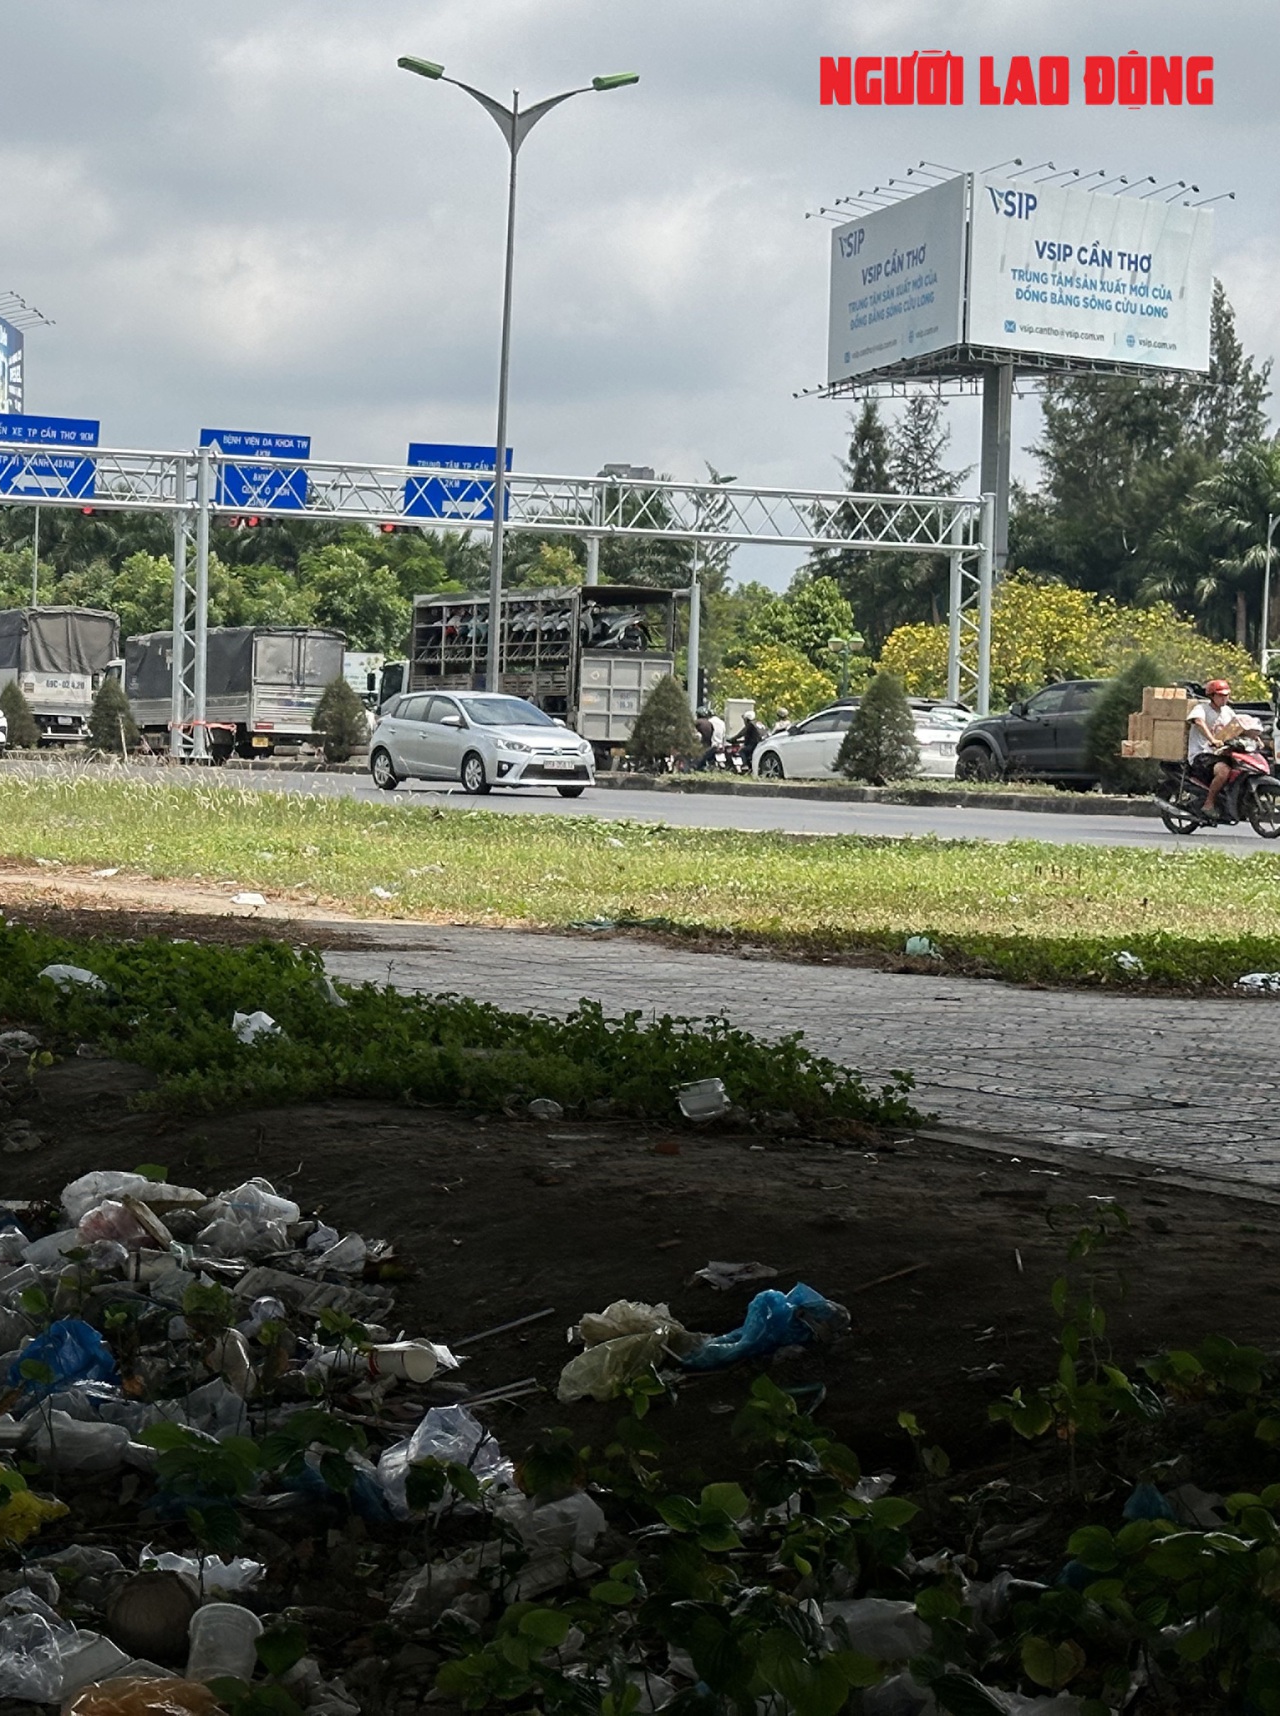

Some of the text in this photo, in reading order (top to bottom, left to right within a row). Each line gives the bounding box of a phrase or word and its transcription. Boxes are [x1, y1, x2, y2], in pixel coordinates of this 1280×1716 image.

[985, 185, 1038, 220] VSIP
[861, 262, 882, 286] VSIP
[906, 243, 927, 270] THƠ
[1035, 240, 1152, 273] VSIP CẦN THƠ
[1011, 268, 1048, 285] TRUNG
[1052, 272, 1073, 288] TÂM
[1082, 294, 1112, 312] SÔNG
[1139, 302, 1169, 319] LONG
[12, 427, 23, 436] XE
[27, 428, 37, 437] TP
[60, 430, 77, 440] THƠ
[274, 439, 294, 448] KHOA
[297, 440, 308, 449] TW
